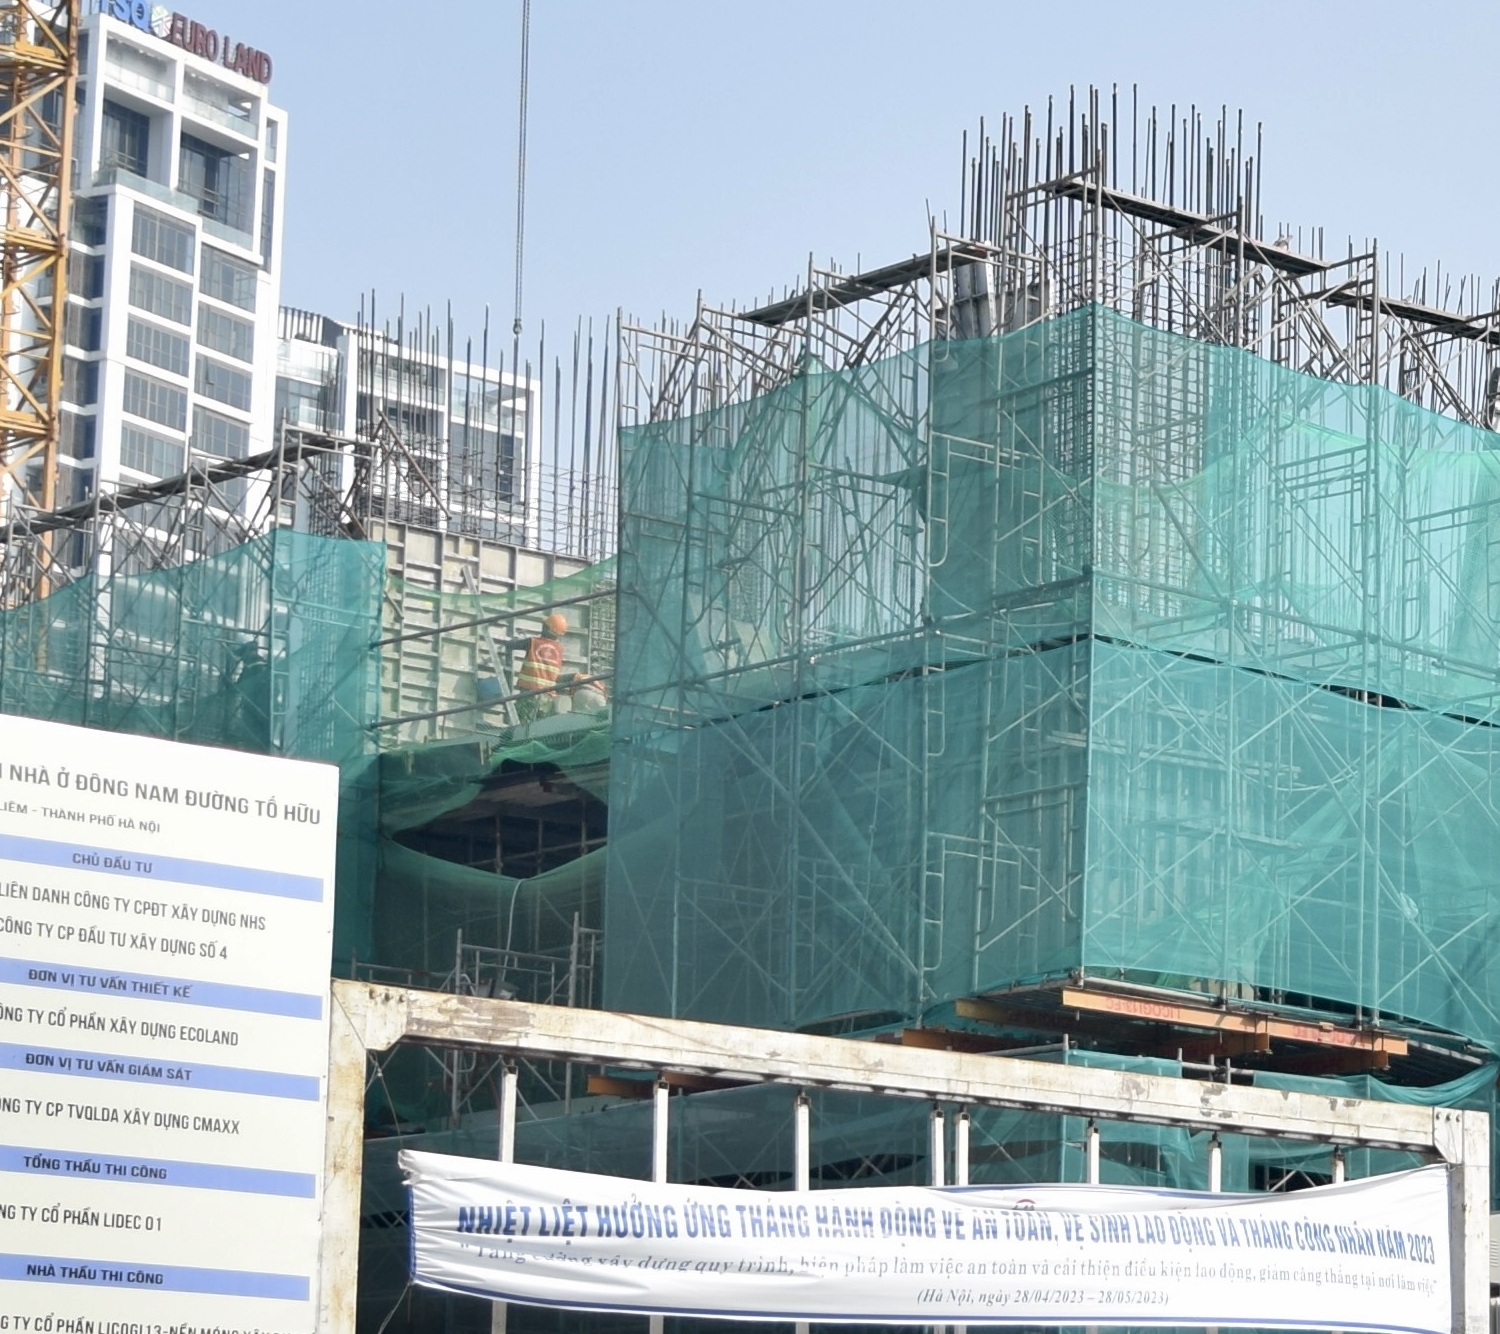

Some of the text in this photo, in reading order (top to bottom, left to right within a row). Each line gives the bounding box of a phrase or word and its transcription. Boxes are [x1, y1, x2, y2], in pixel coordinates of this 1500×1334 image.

[170, 12, 273, 84] EURO LAND
[8, 763, 50, 786] NHÀ
[74, 771, 128, 797] ĐÔNG
[134, 781, 178, 804] NAM
[183, 788, 248, 814] ĐƯỜNG
[254, 794, 277, 818] TỐ
[283, 801, 320, 825] HỮU
[40, 805, 85, 822] THÀNH
[117, 817, 135, 829] HÀ
[138, 819, 160, 833] NỘI
[71, 851, 152, 873] CHỦ TƯ
[31, 885, 70, 905] DANH
[73, 889, 110, 910] CÔNG
[112, 896, 130, 912] TY
[132, 898, 168, 917] CPĐT
[170, 902, 198, 921] XÂY
[200, 907, 236, 927] DỰNG
[239, 912, 266, 931] NHS
[35, 921, 54, 938] TY
[56, 924, 75, 940] CP
[108, 930, 126, 947] TƯ
[128, 931, 156, 951] XÂY
[159, 936, 196, 956] DỰNG
[198, 939, 218, 958] SỐ
[218, 944, 227, 959] 4
[27, 967, 169, 995] ĐƠN TƯ VẤN THIẾT
[26, 1007, 44, 1024] TY
[108, 1015, 136, 1034] XÂY
[139, 1020, 176, 1040] DỰNG
[178, 1024, 238, 1046] ECOLAND
[24, 1052, 192, 1081] ĐƠN TƯ VẤN GIÁM SÁT
[24, 1098, 42, 1115] TY
[44, 1100, 64, 1117] CP
[66, 1102, 119, 1123] TVQLDA
[122, 1106, 150, 1125] XÂY
[153, 1111, 189, 1130] DỰNG
[192, 1115, 239, 1134] CMAXX
[103, 1162, 166, 1179] THI CÔNG
[19, 1204, 38, 1221] TY
[102, 1211, 141, 1230] LIDEC
[144, 1214, 161, 1231] 01
[25, 1262, 163, 1284] NHÀ THI CÔNG
[12, 1314, 30, 1330] TY
